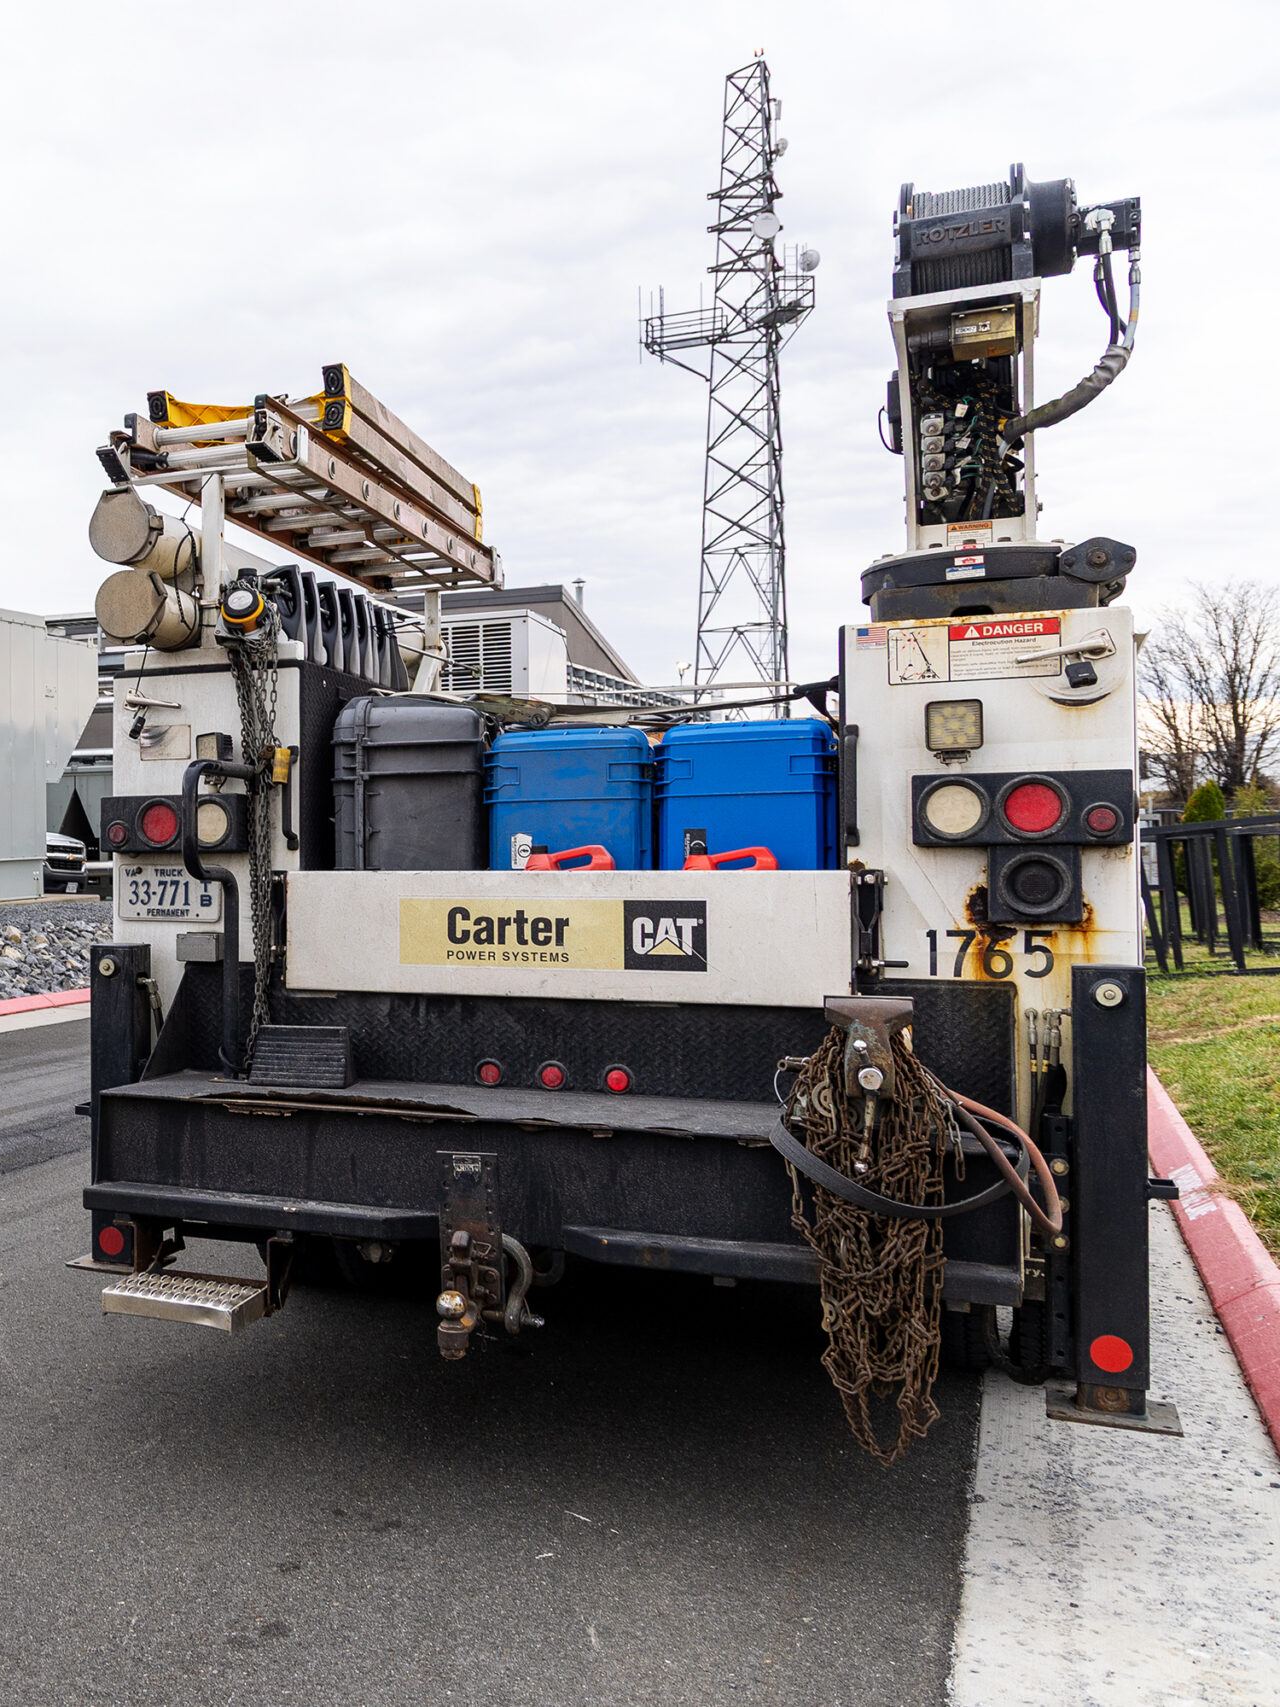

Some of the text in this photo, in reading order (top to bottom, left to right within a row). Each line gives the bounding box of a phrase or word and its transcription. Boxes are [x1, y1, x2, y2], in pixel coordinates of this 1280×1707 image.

[982, 622, 1044, 636] DANGER
[972, 638, 1013, 647] Electrocution
[125, 868, 183, 877] VA TRUCK
[128, 880, 191, 906] 33-771
[146, 908, 190, 917] PERMANENT
[447, 906, 569, 946] Carter
[632, 916, 698, 956] CAT
[446, 950, 569, 963] POWER SYSTEMS
[926, 929, 1055, 979] 1765
